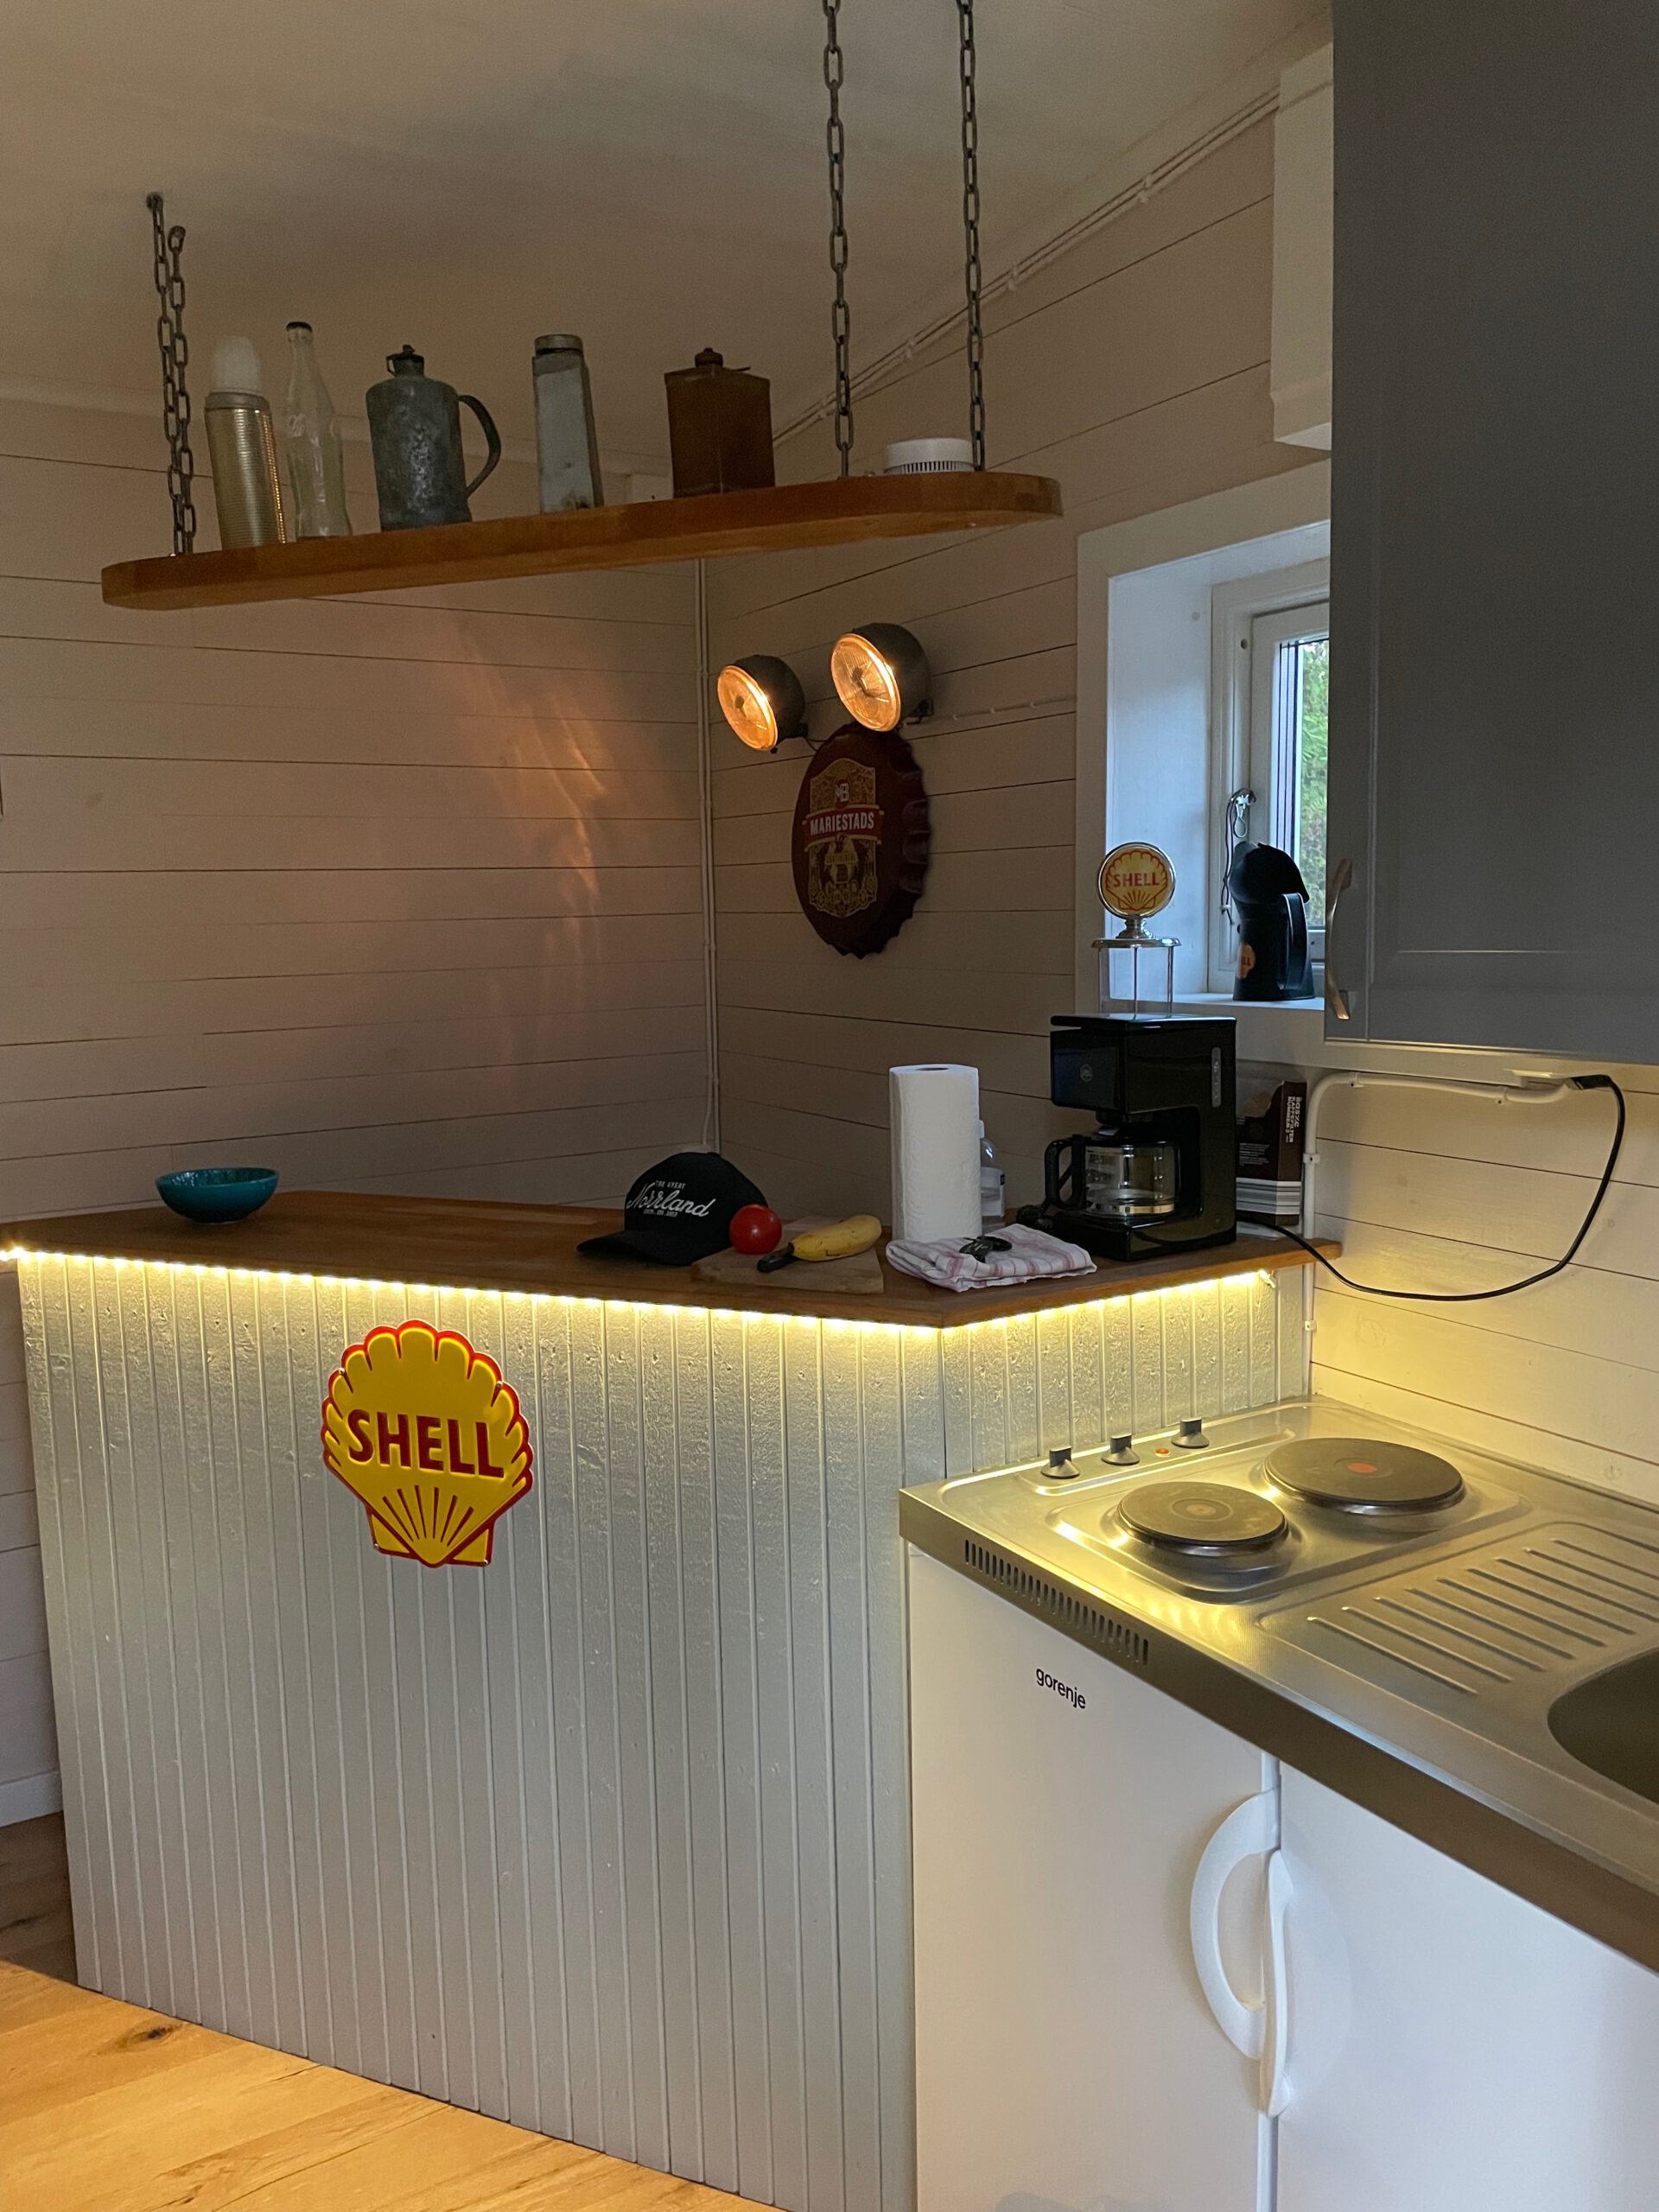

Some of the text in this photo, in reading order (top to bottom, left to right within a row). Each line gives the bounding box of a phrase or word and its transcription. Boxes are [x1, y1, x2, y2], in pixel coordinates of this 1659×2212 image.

[810, 812, 874, 836] MARIESTADS
[1114, 872, 1160, 887] SHELL
[656, 1179, 665, 1188] THE
[626, 1182, 716, 1217] Norrland
[347, 1409, 504, 1478] SHELL
[1036, 1669, 1086, 1709] gorenje
